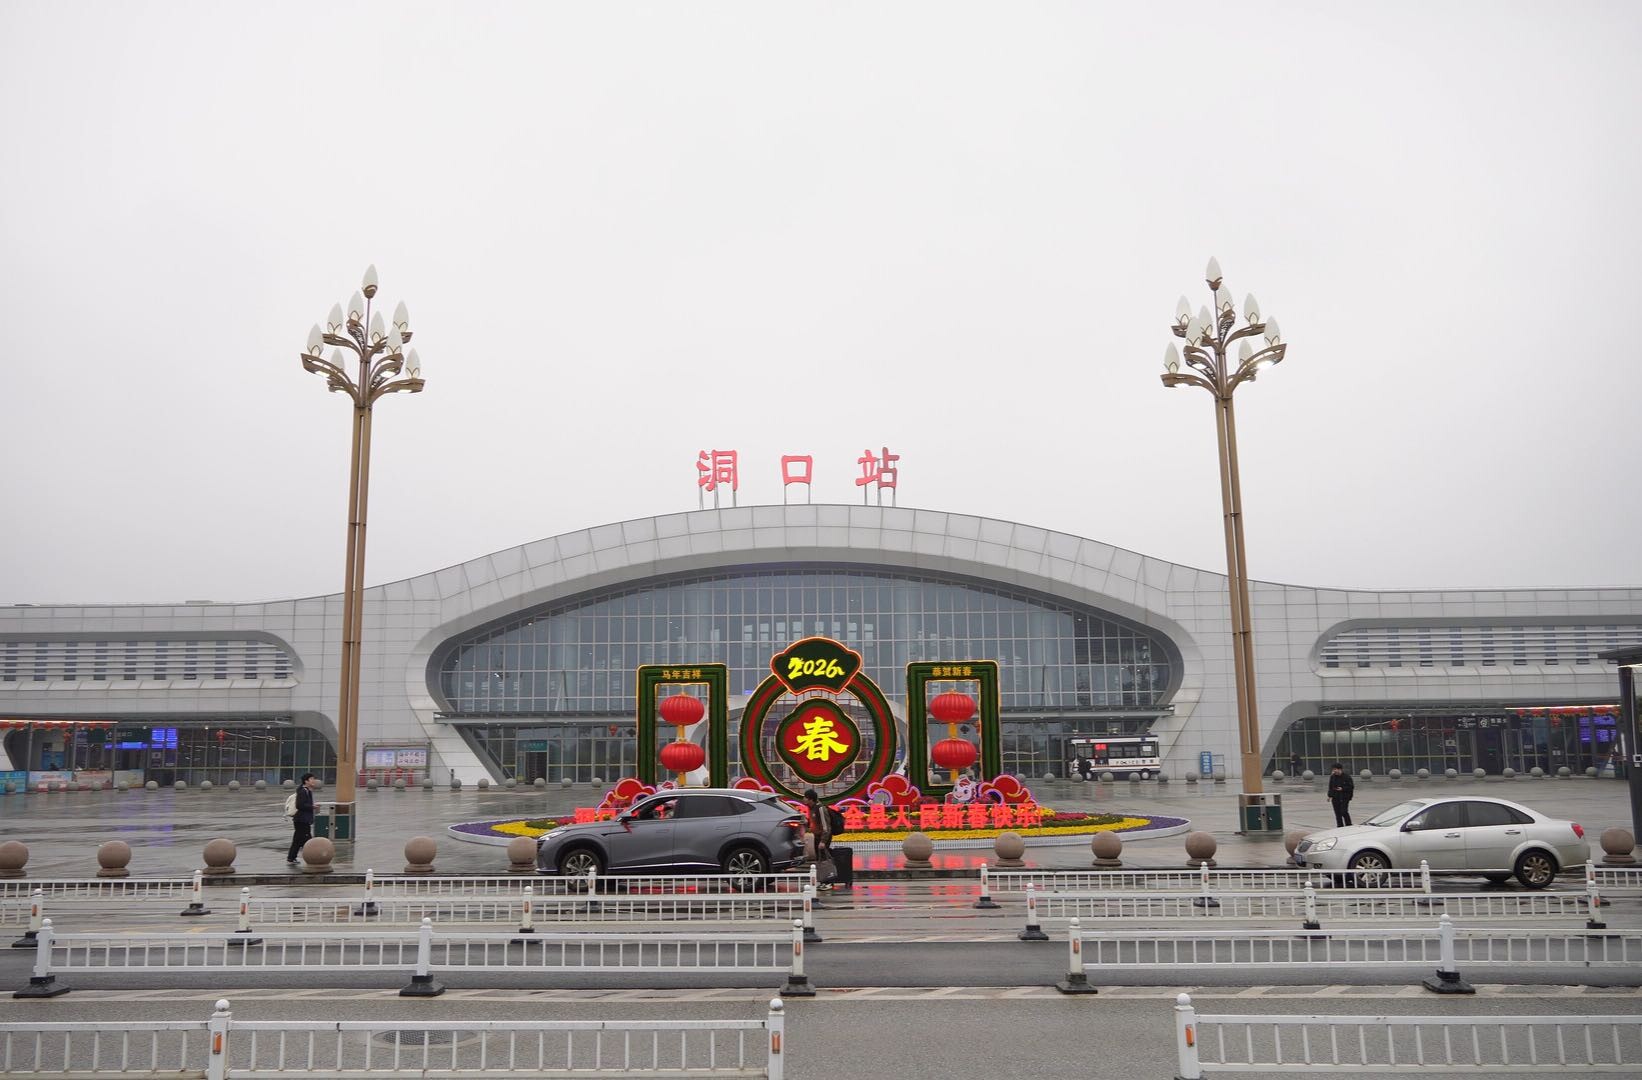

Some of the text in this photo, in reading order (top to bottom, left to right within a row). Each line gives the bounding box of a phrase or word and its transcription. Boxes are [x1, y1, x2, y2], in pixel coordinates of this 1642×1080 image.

[696, 447, 900, 491] 洞口站
[662, 669, 702, 679] 马年吉祥
[788, 657, 845, 679] 2026
[932, 666, 972, 676] 恭贺新春
[789, 716, 850, 761] 春
